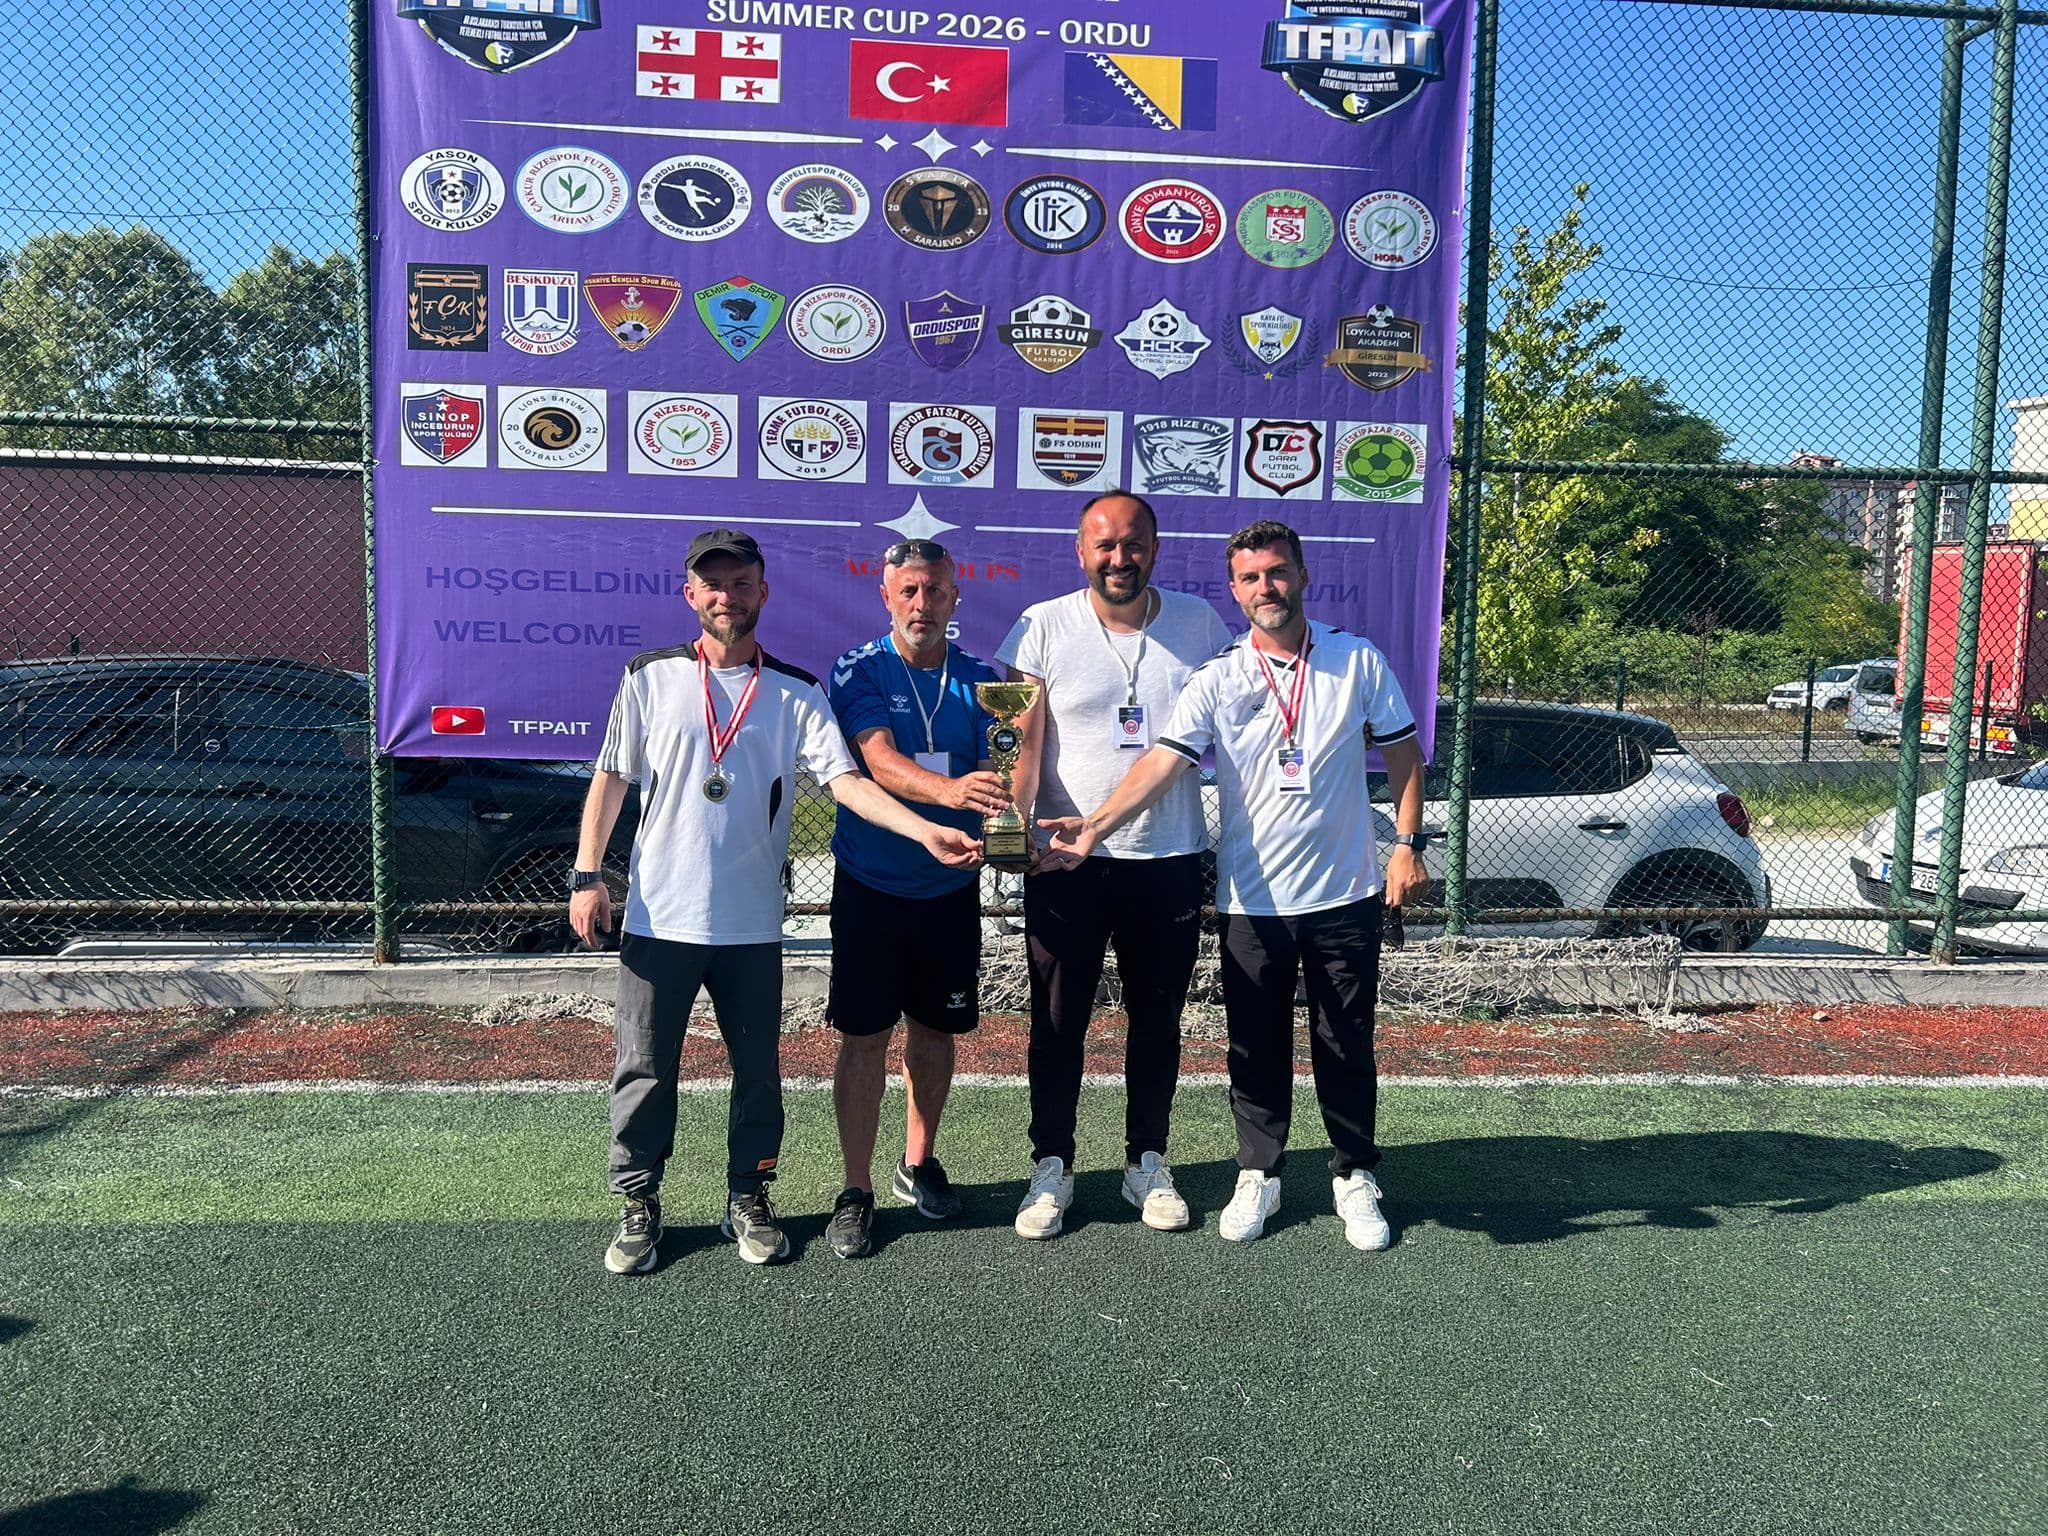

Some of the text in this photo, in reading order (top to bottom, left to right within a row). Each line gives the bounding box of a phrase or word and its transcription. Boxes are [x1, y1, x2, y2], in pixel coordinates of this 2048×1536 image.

[1319, 6, 1363, 14] INTERNATIONAL
[1365, 8, 1408, 18] TOURNAMENTS
[707, 0, 855, 31] SUMMER
[863, 8, 929, 35] CUP
[937, 13, 1026, 41] 2026
[1059, 20, 1151, 48] ORDU
[1278, 24, 1436, 66] TFPAIT
[425, 150, 479, 164] YASON
[524, 153, 621, 217] ÇAYKUR RİZESPOR FUTBOL OKULU
[650, 164, 675, 184] ORDU
[728, 177, 739, 189] 52
[905, 170, 969, 188] SPARTA
[1038, 181, 1064, 189] FUTBOL
[887, 204, 900, 212] 20
[1284, 192, 1318, 209] FUTBOL
[407, 201, 499, 230] SPOR KULÜBÜ
[976, 208, 988, 216] 13
[1402, 196, 1431, 226] FUTBOL
[652, 214, 736, 236] SPOR KULÜBÜ
[1130, 205, 1144, 233] ÜNYE
[1203, 222, 1216, 236] SK
[913, 235, 963, 248] SARAJEVO
[1374, 253, 1405, 263] HOPA
[747, 284, 779, 302] SPOR
[795, 308, 807, 338] ÇAYKUR
[805, 292, 846, 313] RİZESPOR
[847, 294, 873, 318] FUTBOL
[912, 316, 980, 337] ORDUSPOR
[1011, 326, 1090, 343] GİRESUN
[1345, 327, 1413, 340] LOYKA FUTBOL
[509, 335, 534, 352] SPOR
[530, 333, 552, 341] 1957
[934, 335, 956, 346] 1967
[1026, 347, 1074, 357] FUTBOL
[1140, 340, 1185, 353] HCK
[1367, 371, 1389, 379] 2022
[518, 395, 546, 412] LIONS
[585, 426, 599, 434] 22
[644, 404, 725, 456] ÇAYKUR RİZESPOR KULÜBÜ
[767, 405, 860, 450] TERME FUTBOL KULÜBÜ
[1140, 421, 1168, 433] 1918
[1171, 418, 1200, 429] RİZE
[893, 407, 991, 475] TRABZONSPOR FATSA FUTBOL OKULU
[1067, 440, 1102, 448] ODISHI
[1393, 429, 1416, 446] SPOR
[514, 440, 592, 461] FOOTBALL CLUB
[670, 457, 697, 466] 1953
[796, 465, 827, 474] 2018
[1155, 475, 1181, 484] FUTBOL
[1364, 489, 1392, 498] 2015
[426, 566, 688, 596] HOŞGELDİNİZ
[433, 619, 642, 647] WELCOME
[508, 720, 592, 736] TFPAIT
